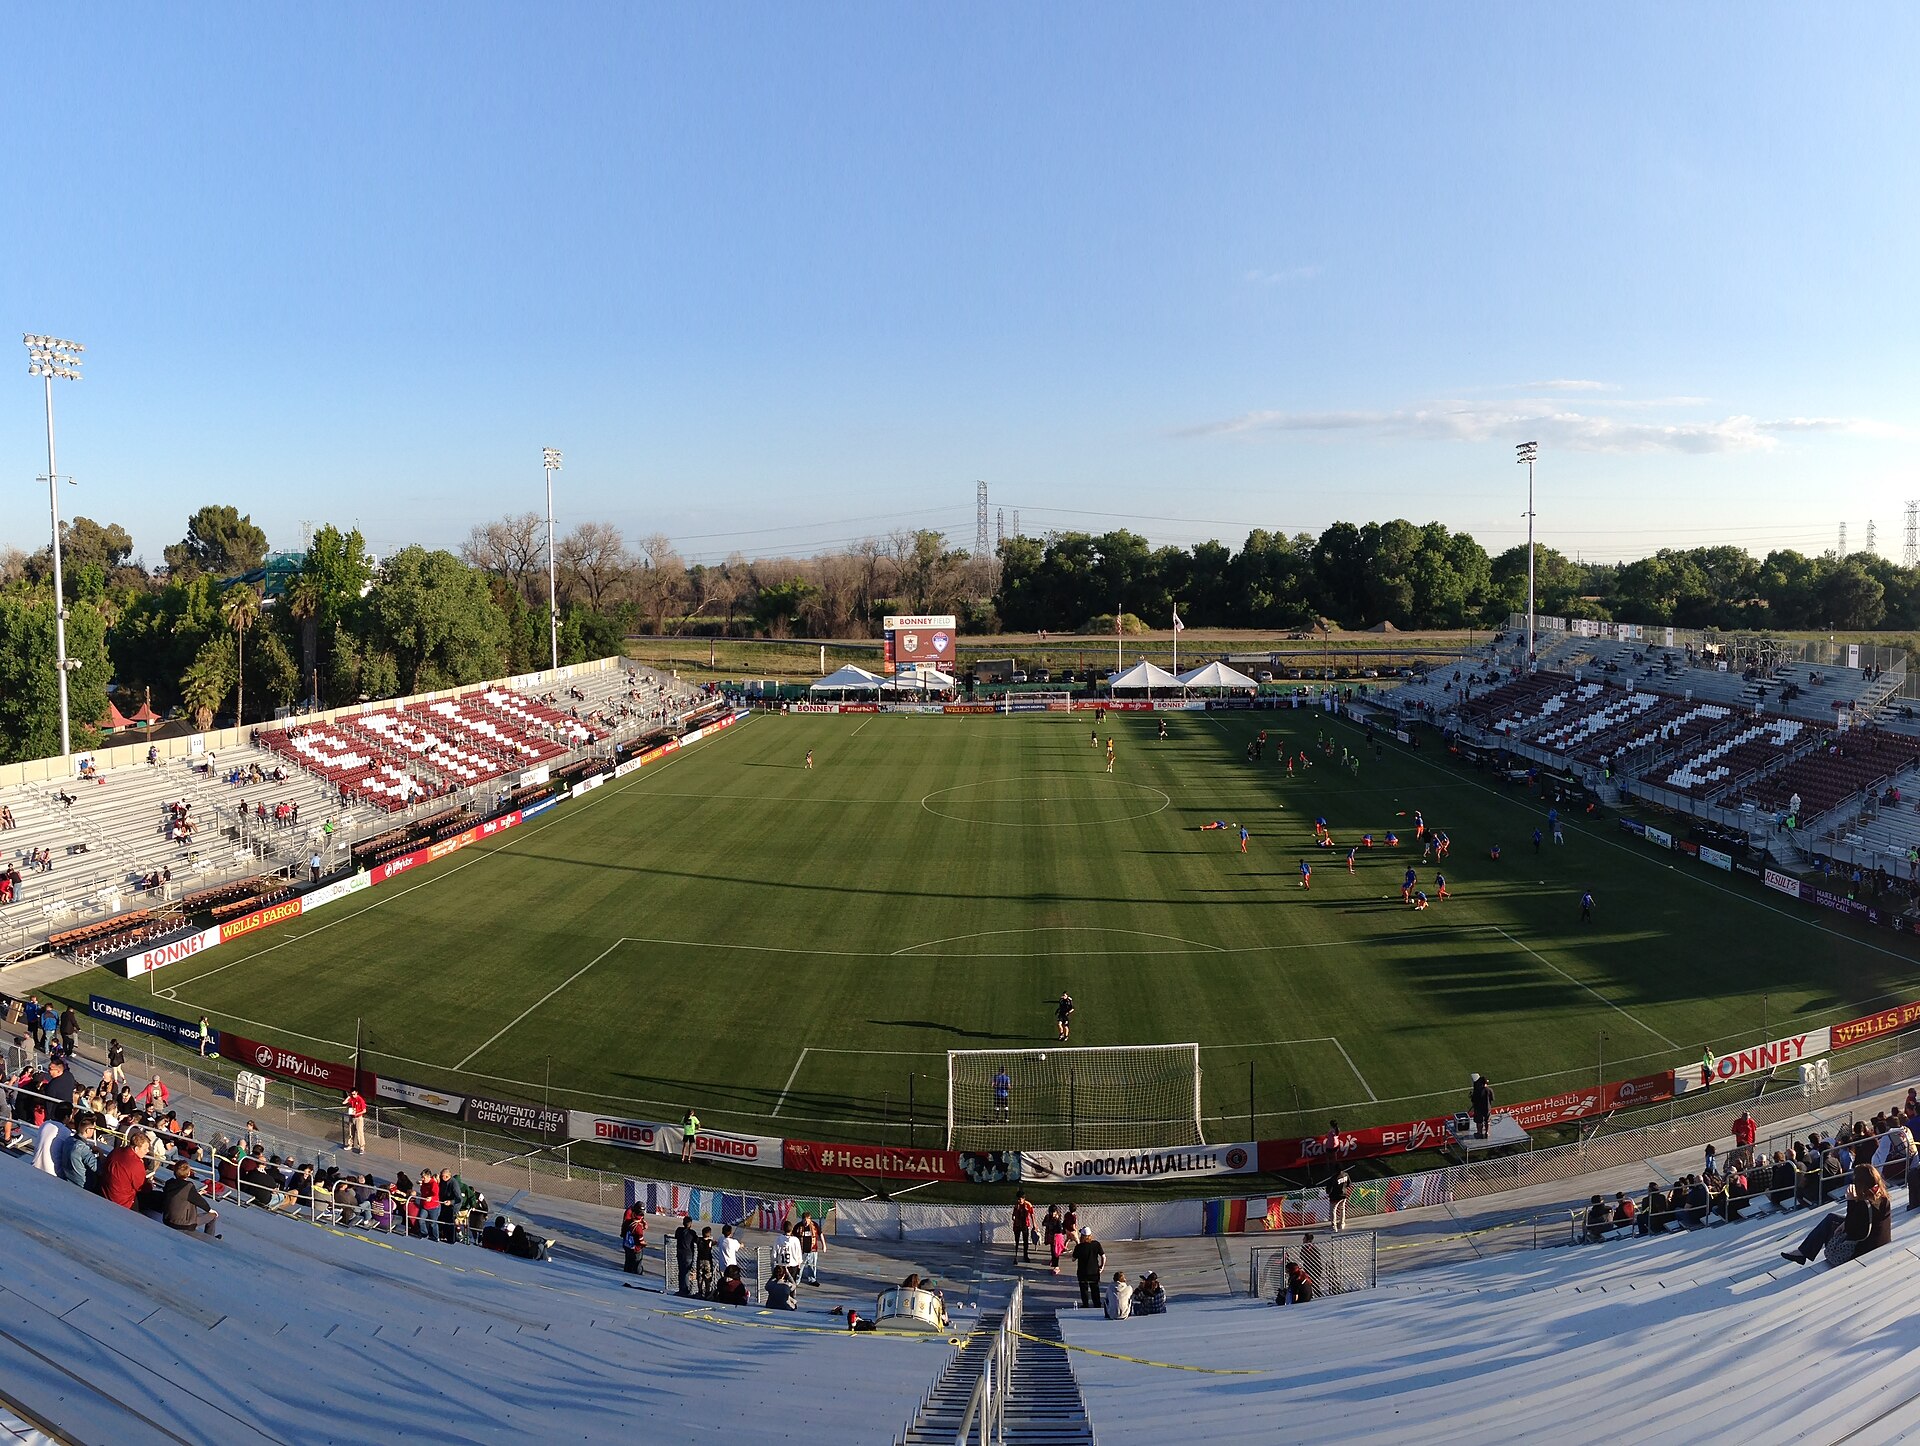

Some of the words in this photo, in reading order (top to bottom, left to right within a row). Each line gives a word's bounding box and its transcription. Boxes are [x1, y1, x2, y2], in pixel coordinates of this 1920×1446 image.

[222, 915, 260, 939] WELLS
[262, 901, 300, 924] FARGO
[143, 933, 206, 971] BONNEY
[135, 1014, 177, 1033] CHILDREN'S
[179, 1027, 216, 1045] HOSPAL
[1836, 1012, 1898, 1043] WELLS
[381, 1084, 416, 1097] CHEVROLET
[1544, 1094, 1579, 1109] Health
[470, 1098, 535, 1119] SACRAMENTO
[538, 1111, 564, 1124] AREA
[477, 1110, 508, 1125] CHEVY
[512, 1116, 557, 1132] DEALERS
[595, 1122, 654, 1143] BIMBO
[695, 1136, 758, 1158] BIMBO
[821, 1150, 946, 1175] #Health4All
[1063, 1153, 1217, 1176] GOOOOAAAAALLLL!
